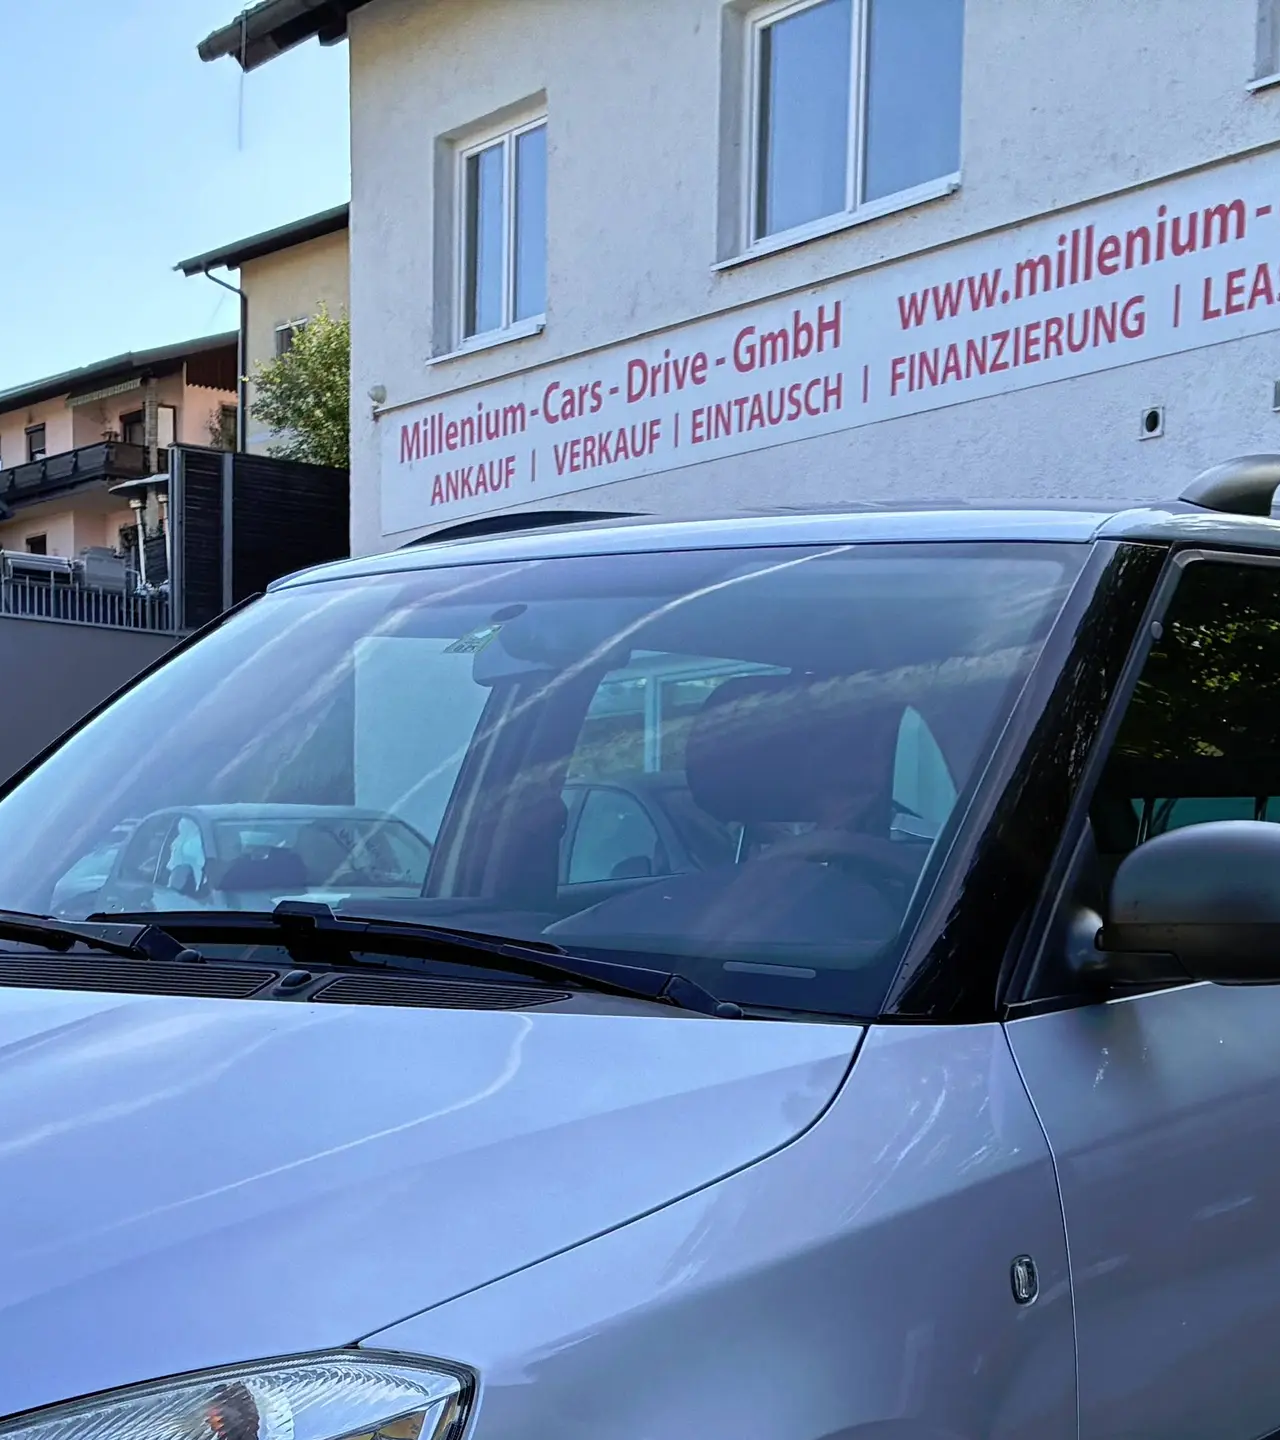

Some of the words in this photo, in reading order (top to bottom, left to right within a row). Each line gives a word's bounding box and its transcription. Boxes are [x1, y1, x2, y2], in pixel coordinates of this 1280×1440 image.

[430, 455, 516, 505] ANKAUF
[553, 418, 661, 476] VERKAUF
[690, 372, 842, 444] EINTAUSCH
[890, 294, 1146, 396] FINANZIERUNG
